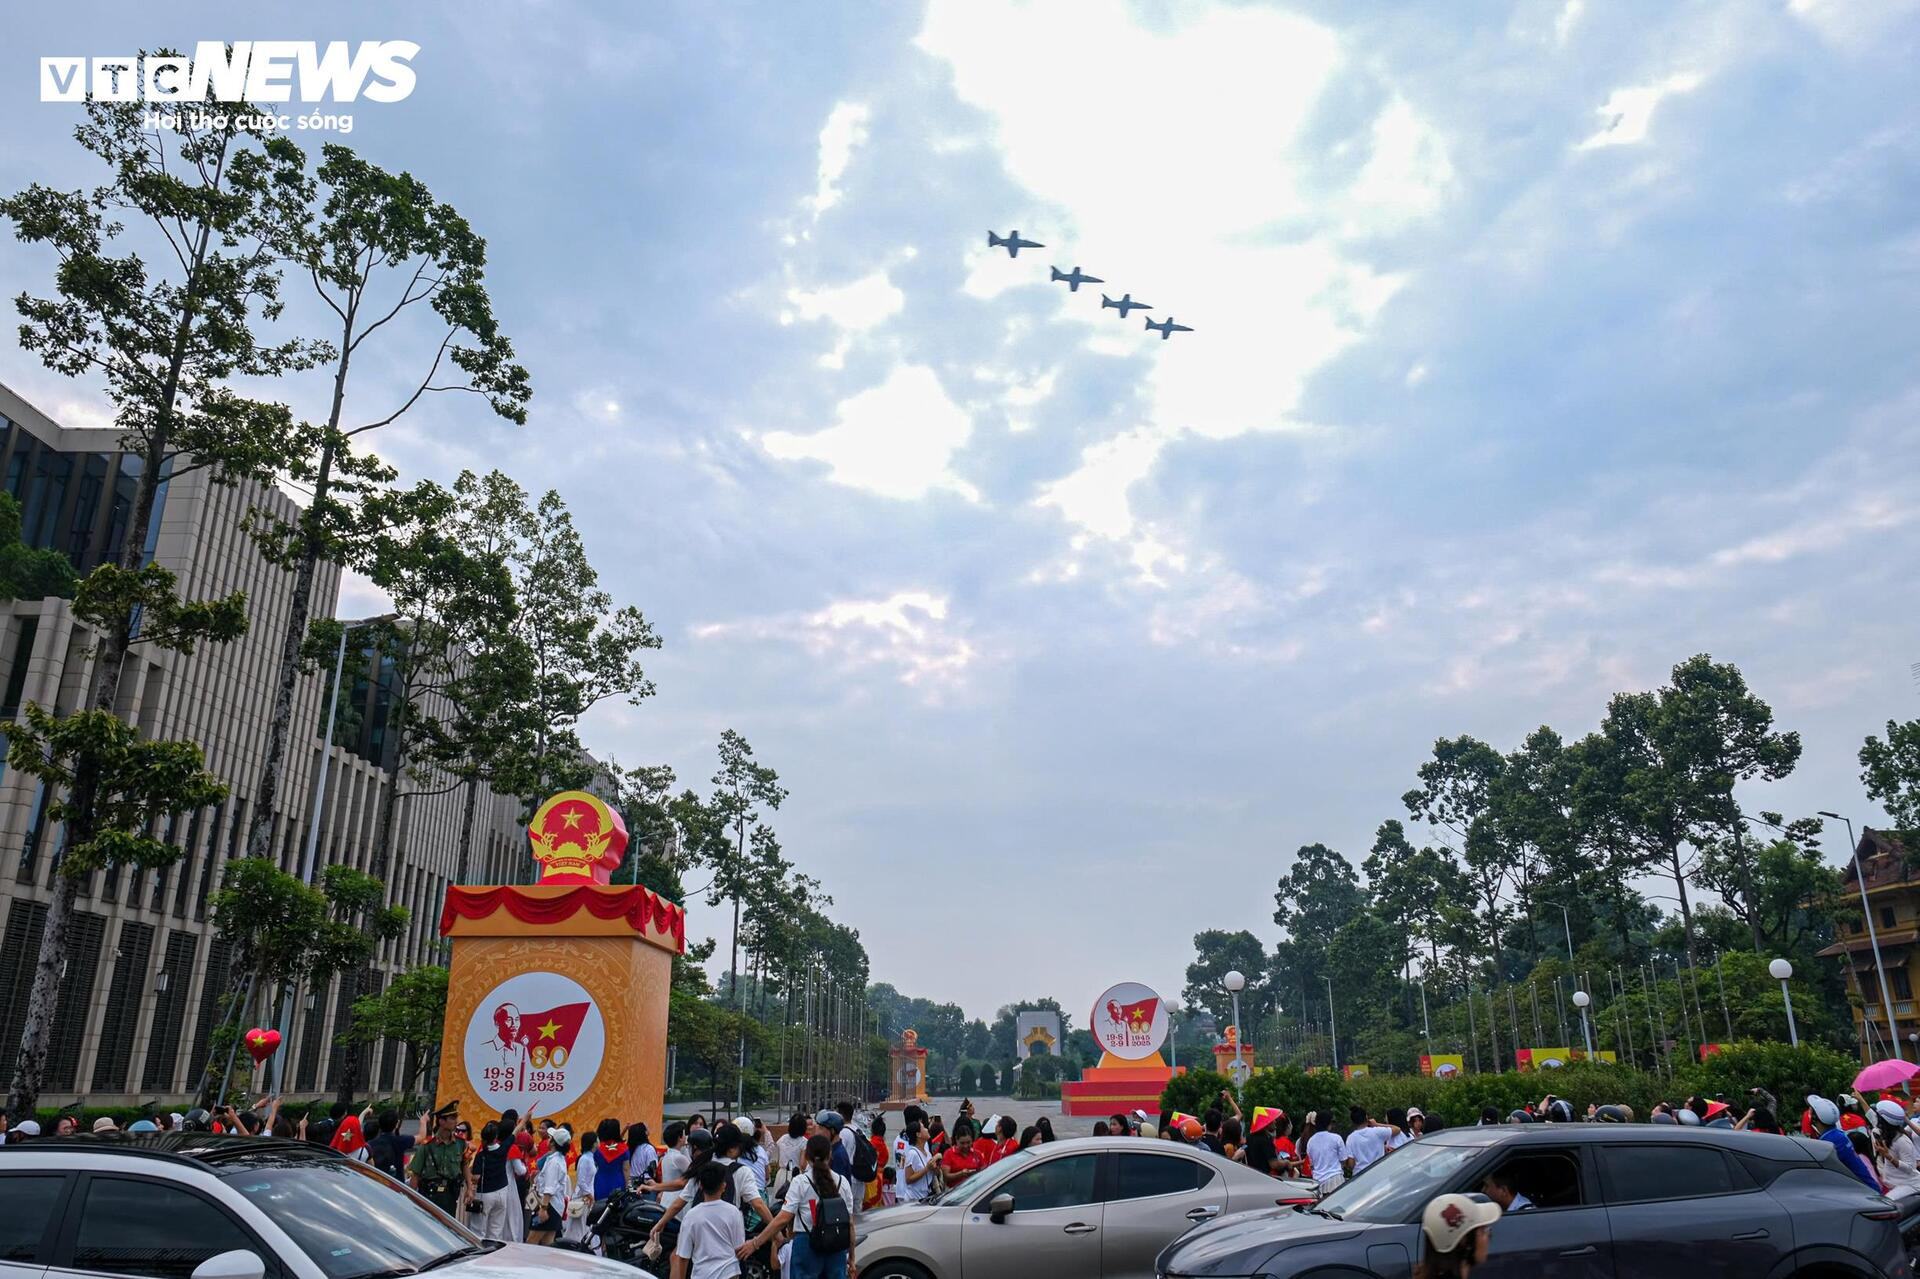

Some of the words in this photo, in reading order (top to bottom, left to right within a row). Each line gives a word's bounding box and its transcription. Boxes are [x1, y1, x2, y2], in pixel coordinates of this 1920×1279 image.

[1130, 1021, 1151, 1034] 80
[531, 1045, 568, 1069] 80
[483, 1067, 515, 1079] 19-8
[529, 1071, 565, 1081] 1945
[489, 1080, 514, 1092] 2-9
[528, 1082, 564, 1092] 2025
